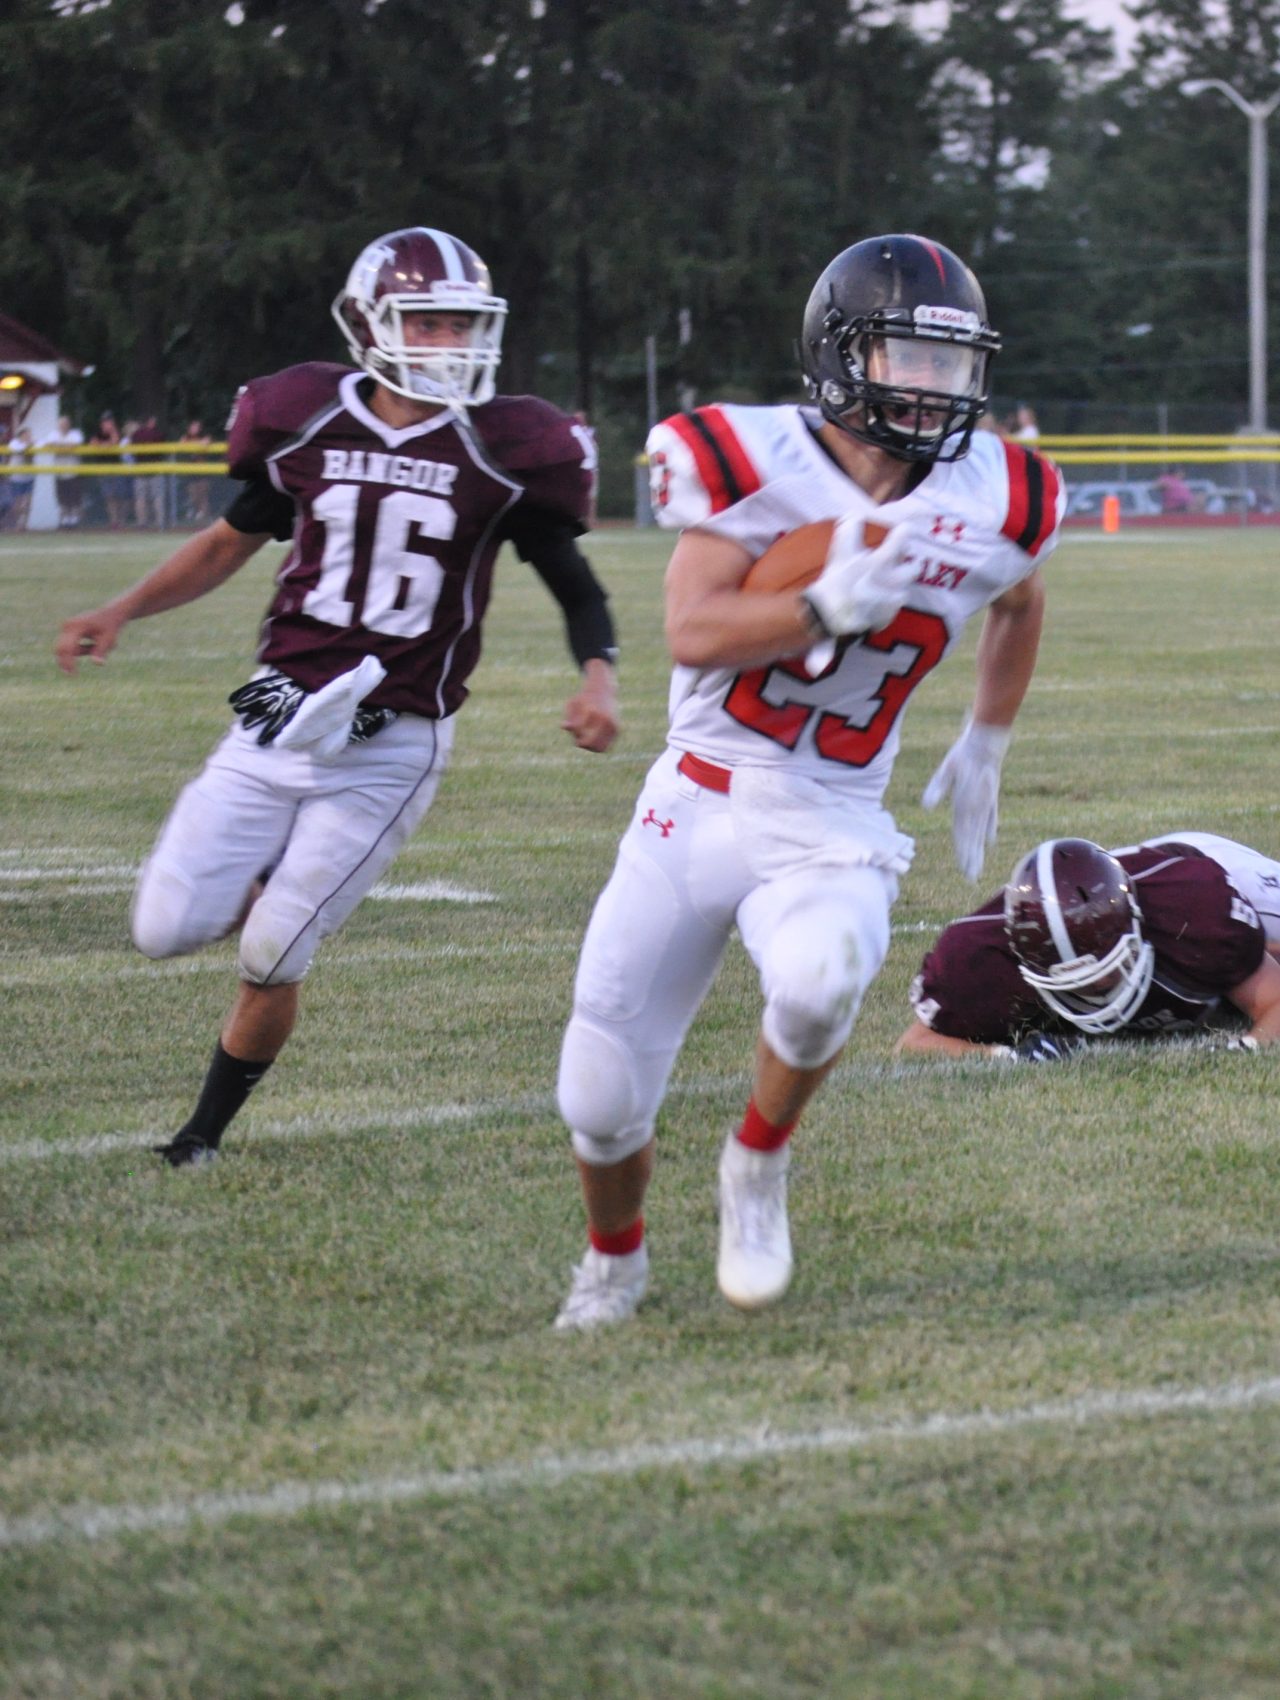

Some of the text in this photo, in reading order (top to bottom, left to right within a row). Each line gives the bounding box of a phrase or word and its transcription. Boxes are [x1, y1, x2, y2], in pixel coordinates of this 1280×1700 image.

[321, 448, 460, 496] BANGOR
[303, 483, 459, 639] 16
[903, 555, 970, 592] LEY
[722, 606, 949, 769] 23
